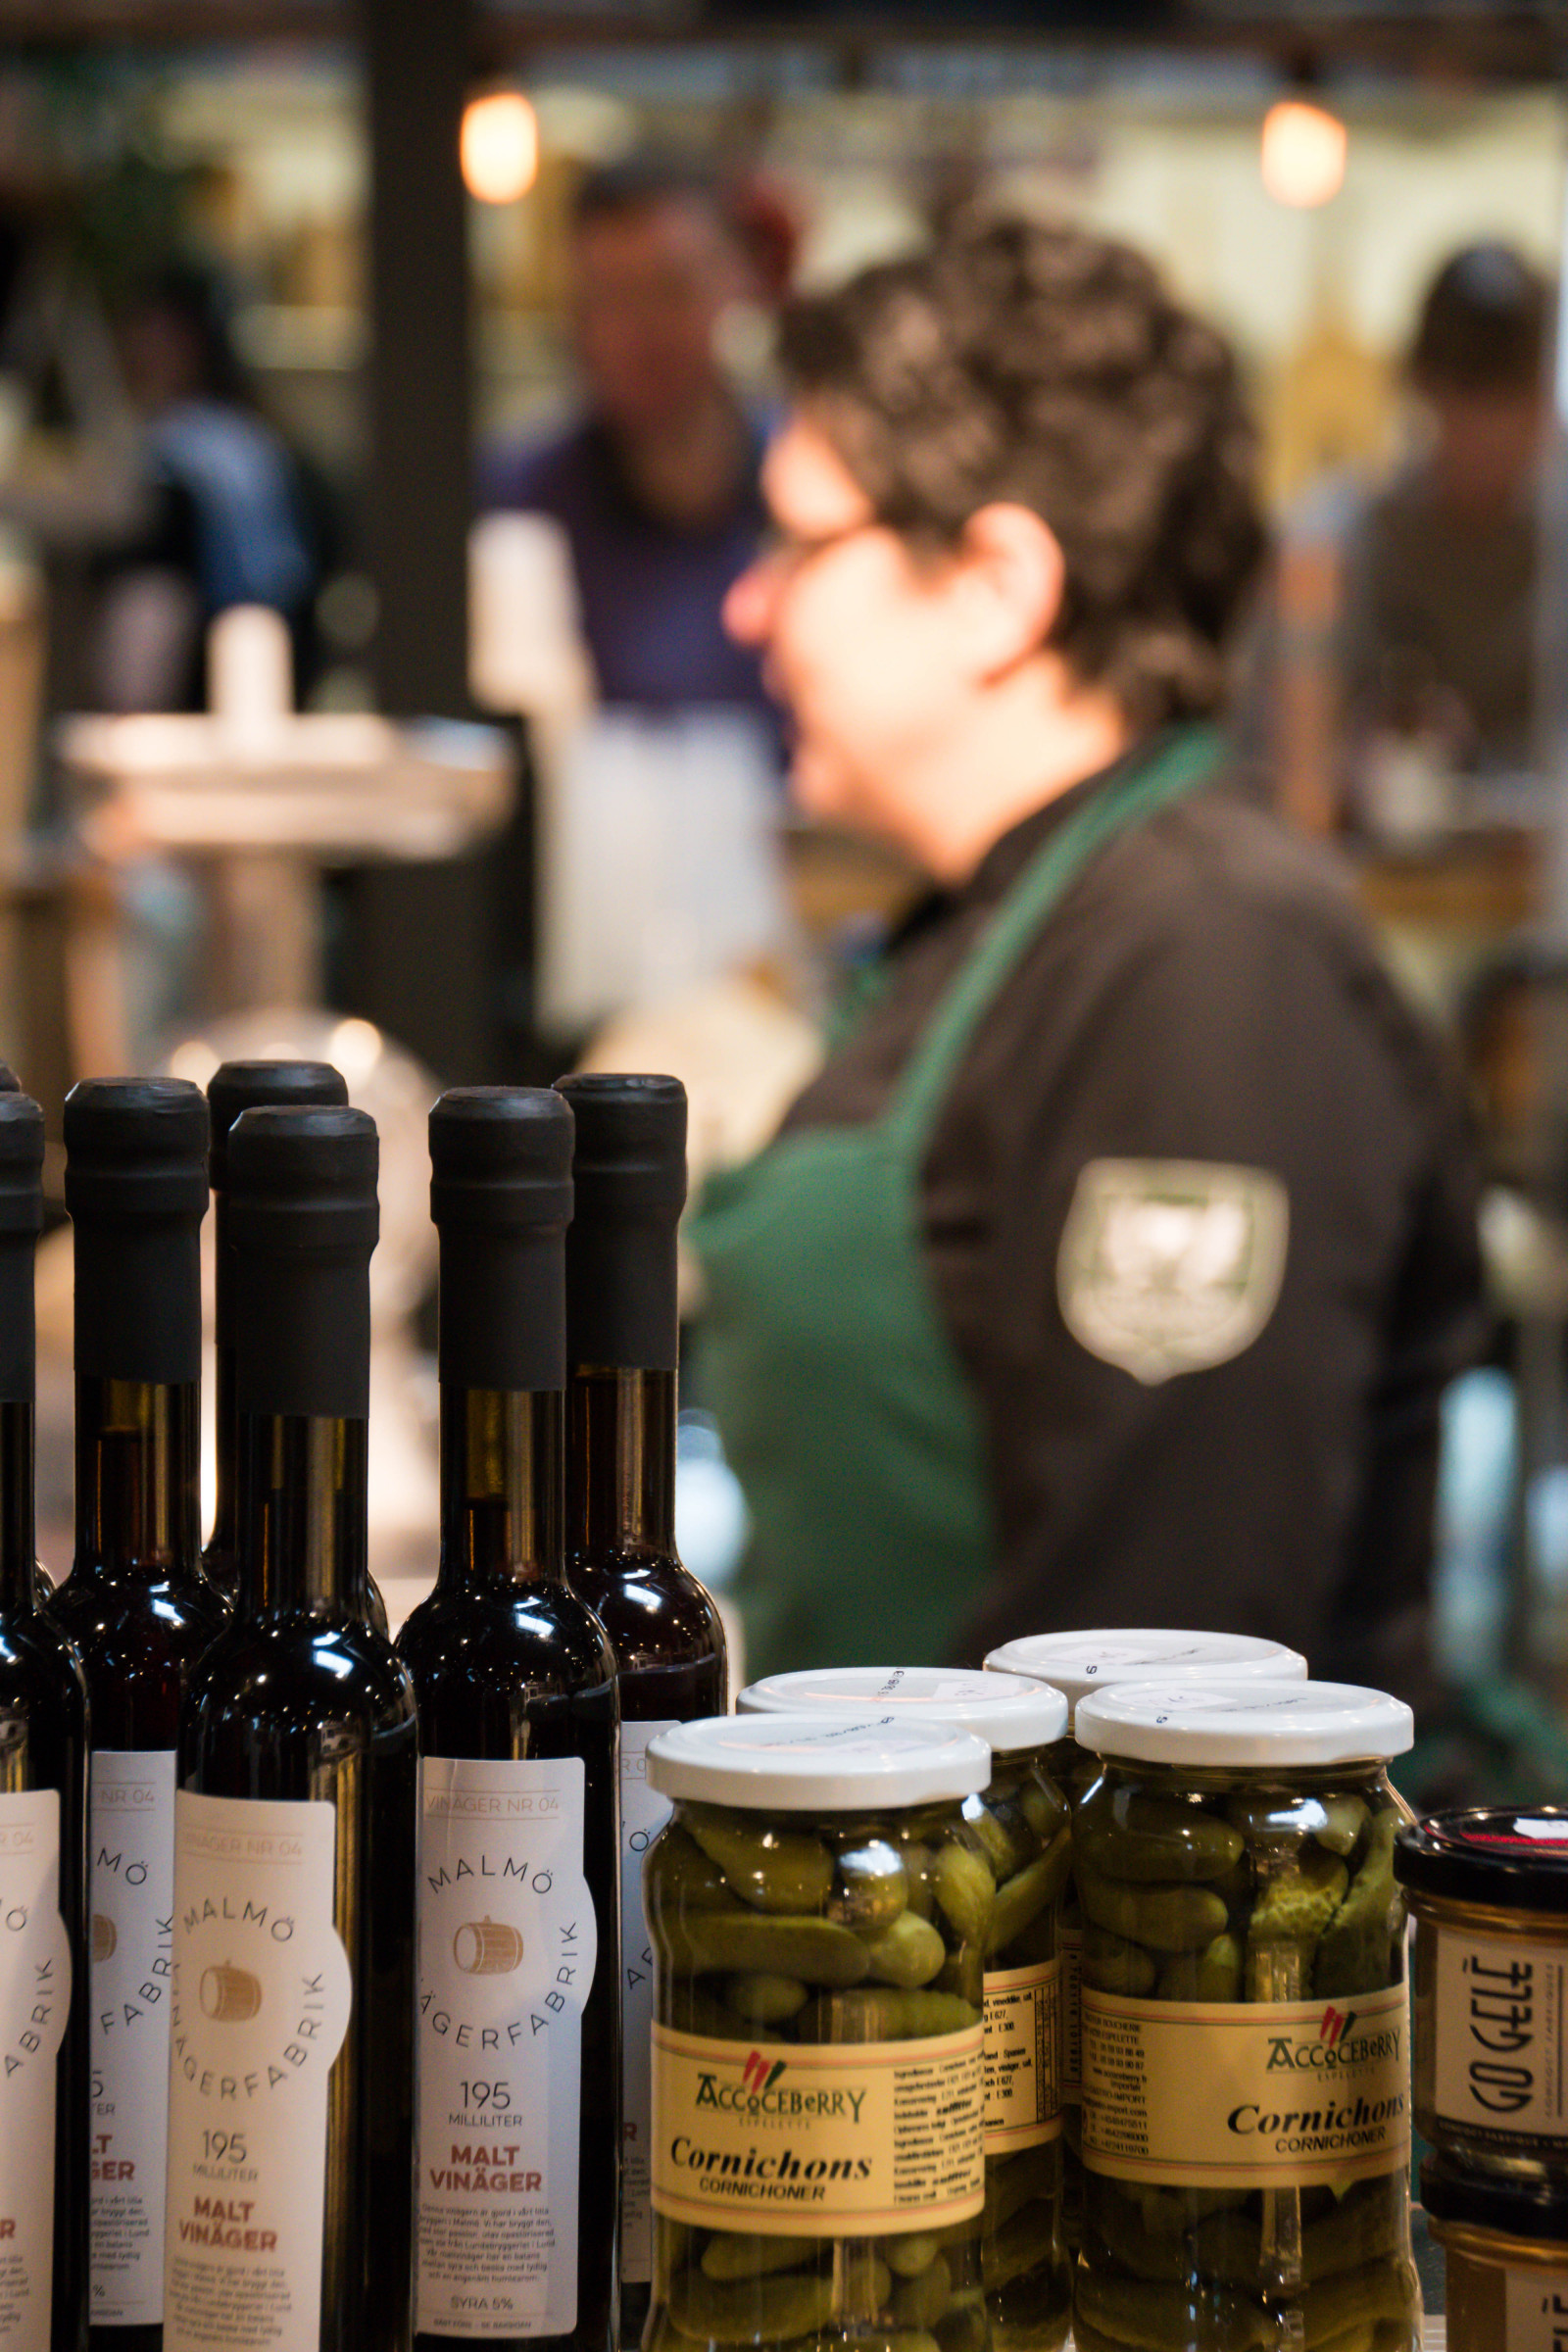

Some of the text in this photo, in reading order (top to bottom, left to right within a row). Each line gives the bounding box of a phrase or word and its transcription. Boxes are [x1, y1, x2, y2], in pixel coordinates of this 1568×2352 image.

[508, 1797, 534, 1813] NR
[538, 1795, 560, 1813] 04
[427, 1854, 554, 1895] MALMÖ
[183, 1896, 294, 1942] MALMÖ
[419, 1921, 578, 2051] ÄGERFABRIK
[460, 2081, 511, 2110] 195
[448, 2112, 522, 2128] MILLILITER
[1227, 2092, 1404, 2135] Cornichons
[202, 2129, 247, 2164] 195
[1274, 2125, 1387, 2154] CORNICHONER
[451, 2144, 520, 2167] MALT
[670, 2134, 872, 2181] Cornichons
[429, 2167, 542, 2193] VINÄGER
[699, 2176, 826, 2202] CORNICHONER
[193, 2195, 255, 2223] MALT
[178, 2219, 278, 2252] VINÄGER
